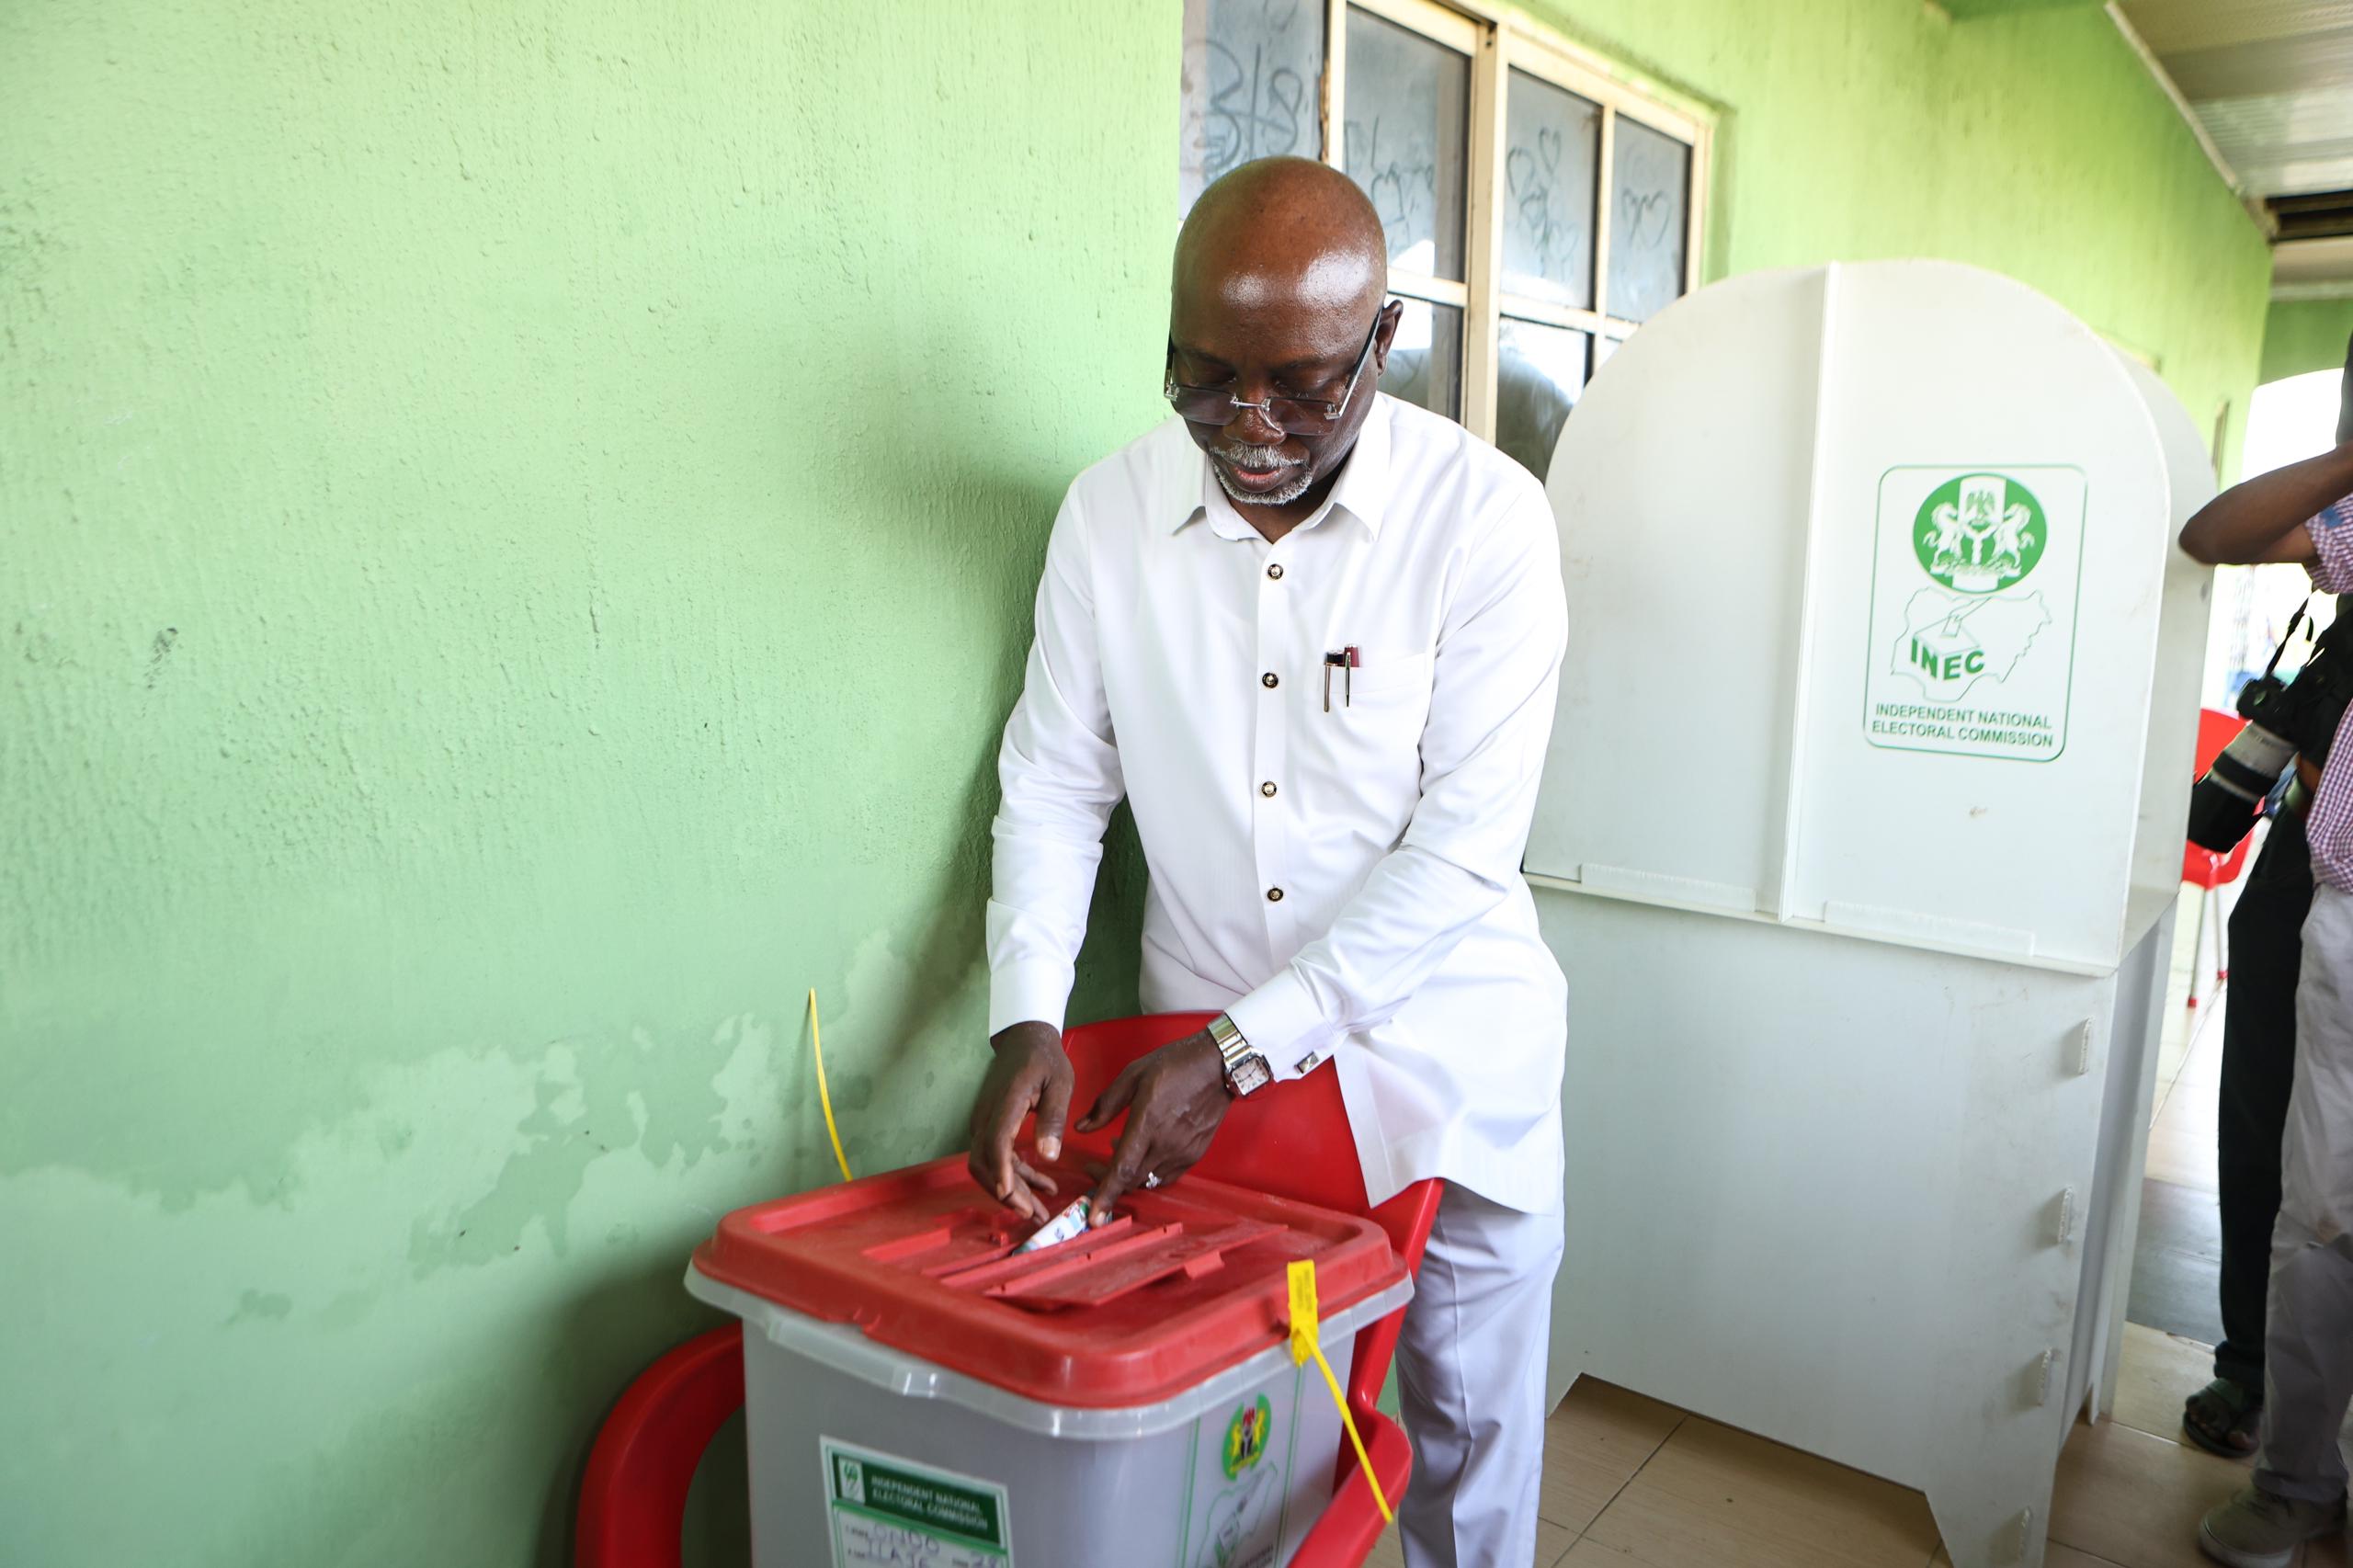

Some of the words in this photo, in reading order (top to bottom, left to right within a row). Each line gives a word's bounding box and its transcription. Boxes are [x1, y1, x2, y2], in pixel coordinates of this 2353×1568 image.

[1910, 638, 1985, 681] INEC
[1871, 721, 1954, 740] ELECTORAL
[1958, 725, 2053, 747] COMMISSION
[1876, 703, 1974, 722] INDEPENDENT
[1978, 711, 2053, 730] NATIONAL
[871, 1475, 934, 1500] INDEPENDENT
[935, 1491, 982, 1513] NATIONAL
[872, 1488, 923, 1511] ELECTORAL
[927, 1503, 988, 1528] COMMISSION
